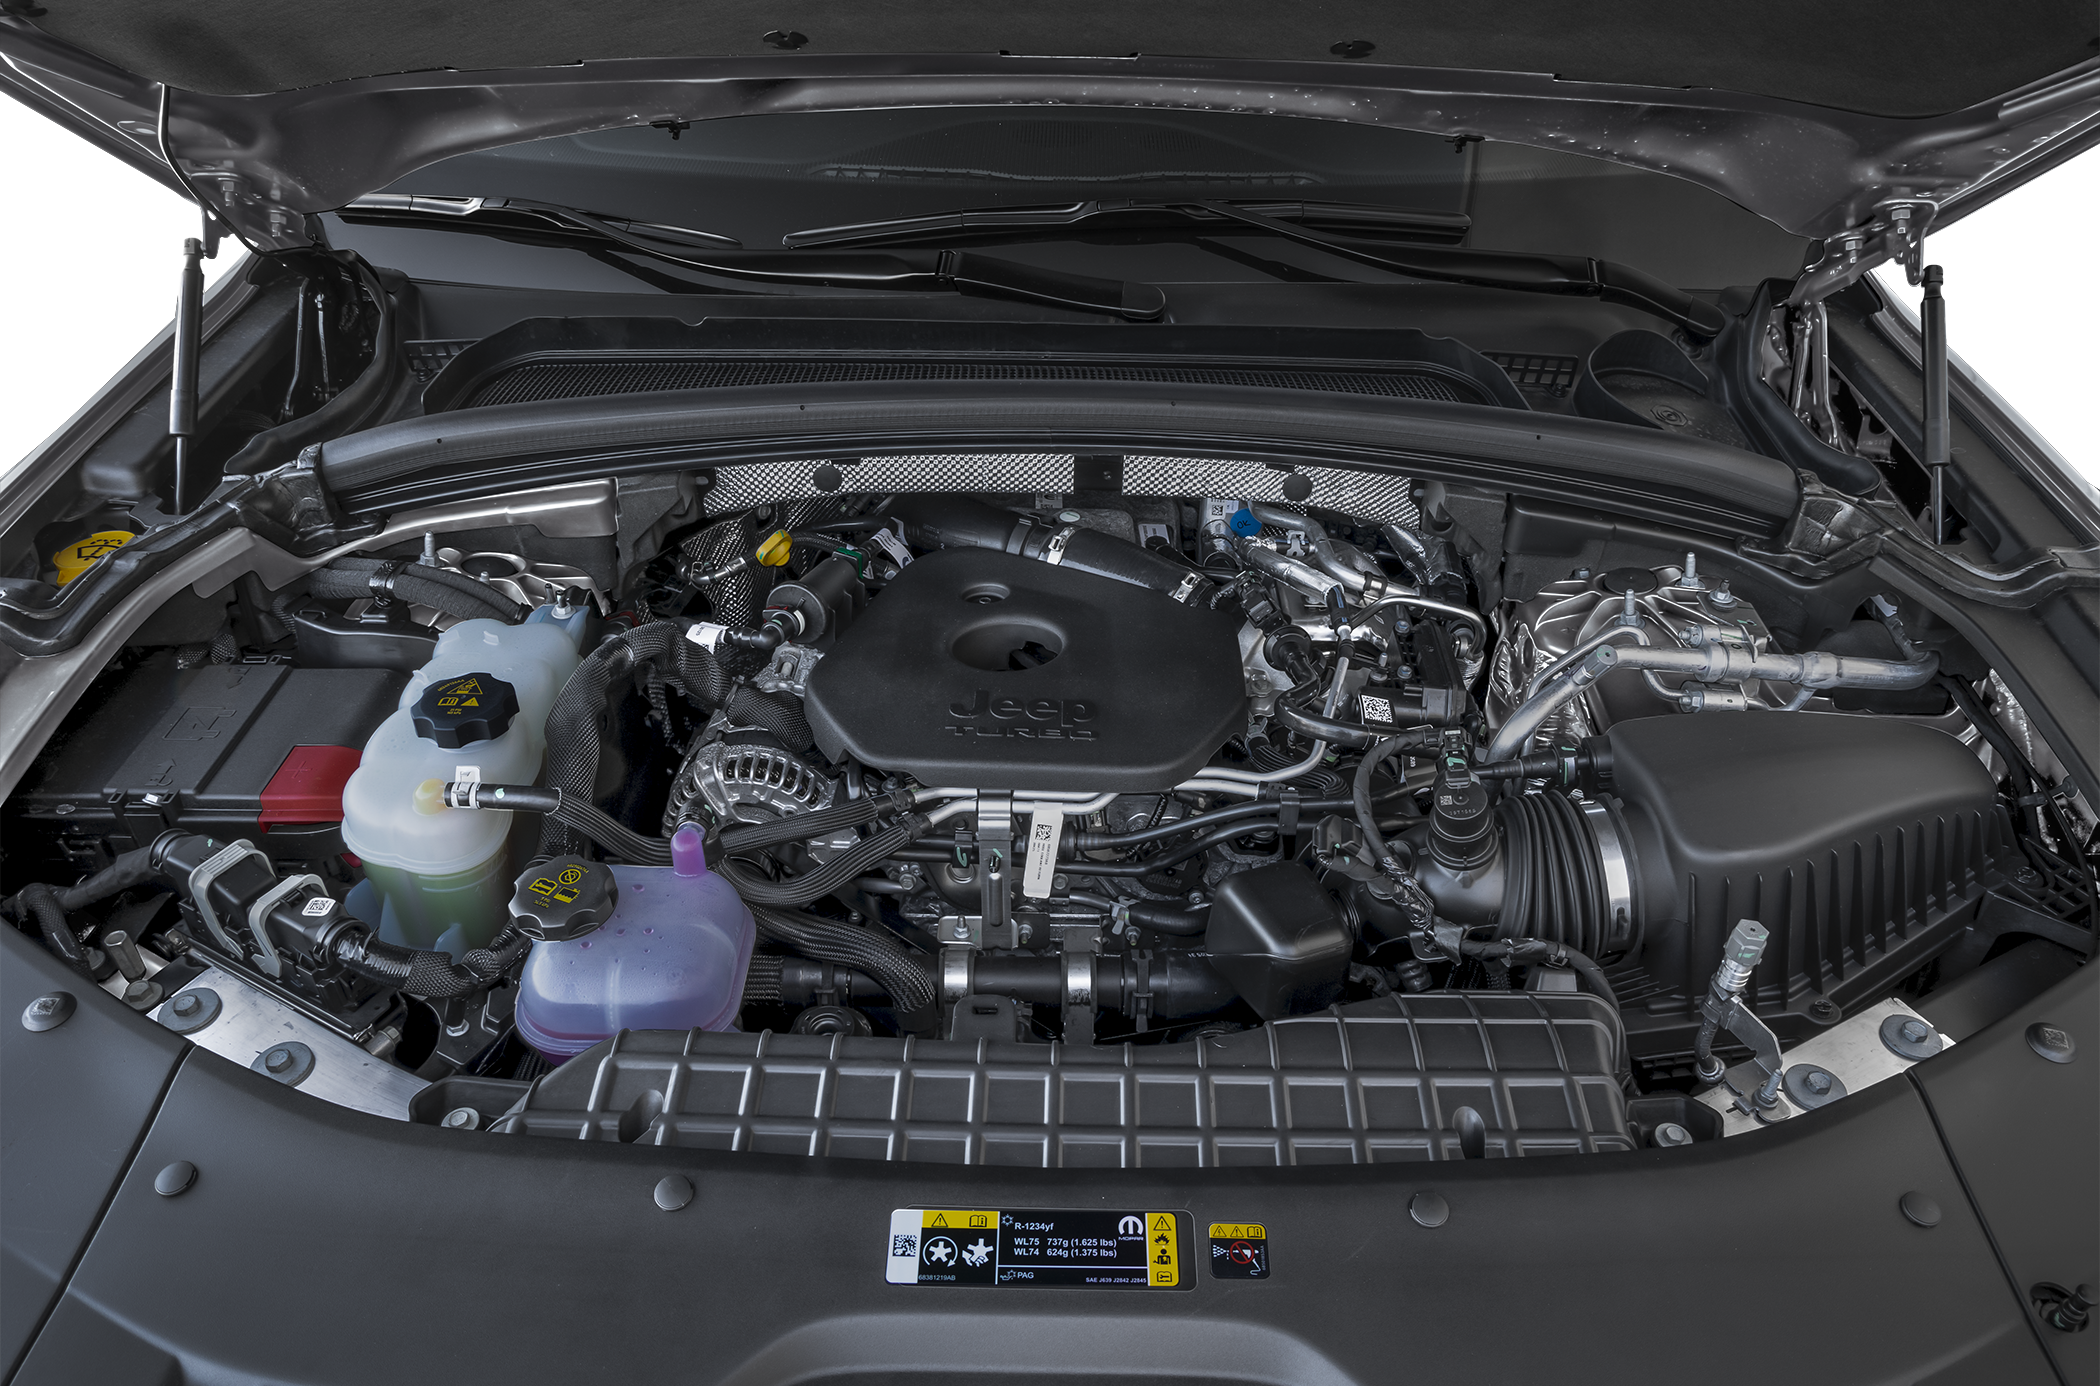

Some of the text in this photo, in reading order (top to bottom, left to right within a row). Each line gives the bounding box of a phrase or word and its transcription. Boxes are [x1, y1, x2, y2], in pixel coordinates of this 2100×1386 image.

[1236, 519, 1252, 530] OK
[948, 689, 1098, 728] Jeep
[944, 725, 1100, 742] TURBO
[1014, 1222, 1055, 1233] R-1234yf
[1013, 1237, 1118, 1248] WL75 737g (1.625 lbs)
[1013, 1247, 1118, 1259] WL74 624g (1.375 lbs)
[1017, 1271, 1035, 1279] PAG
